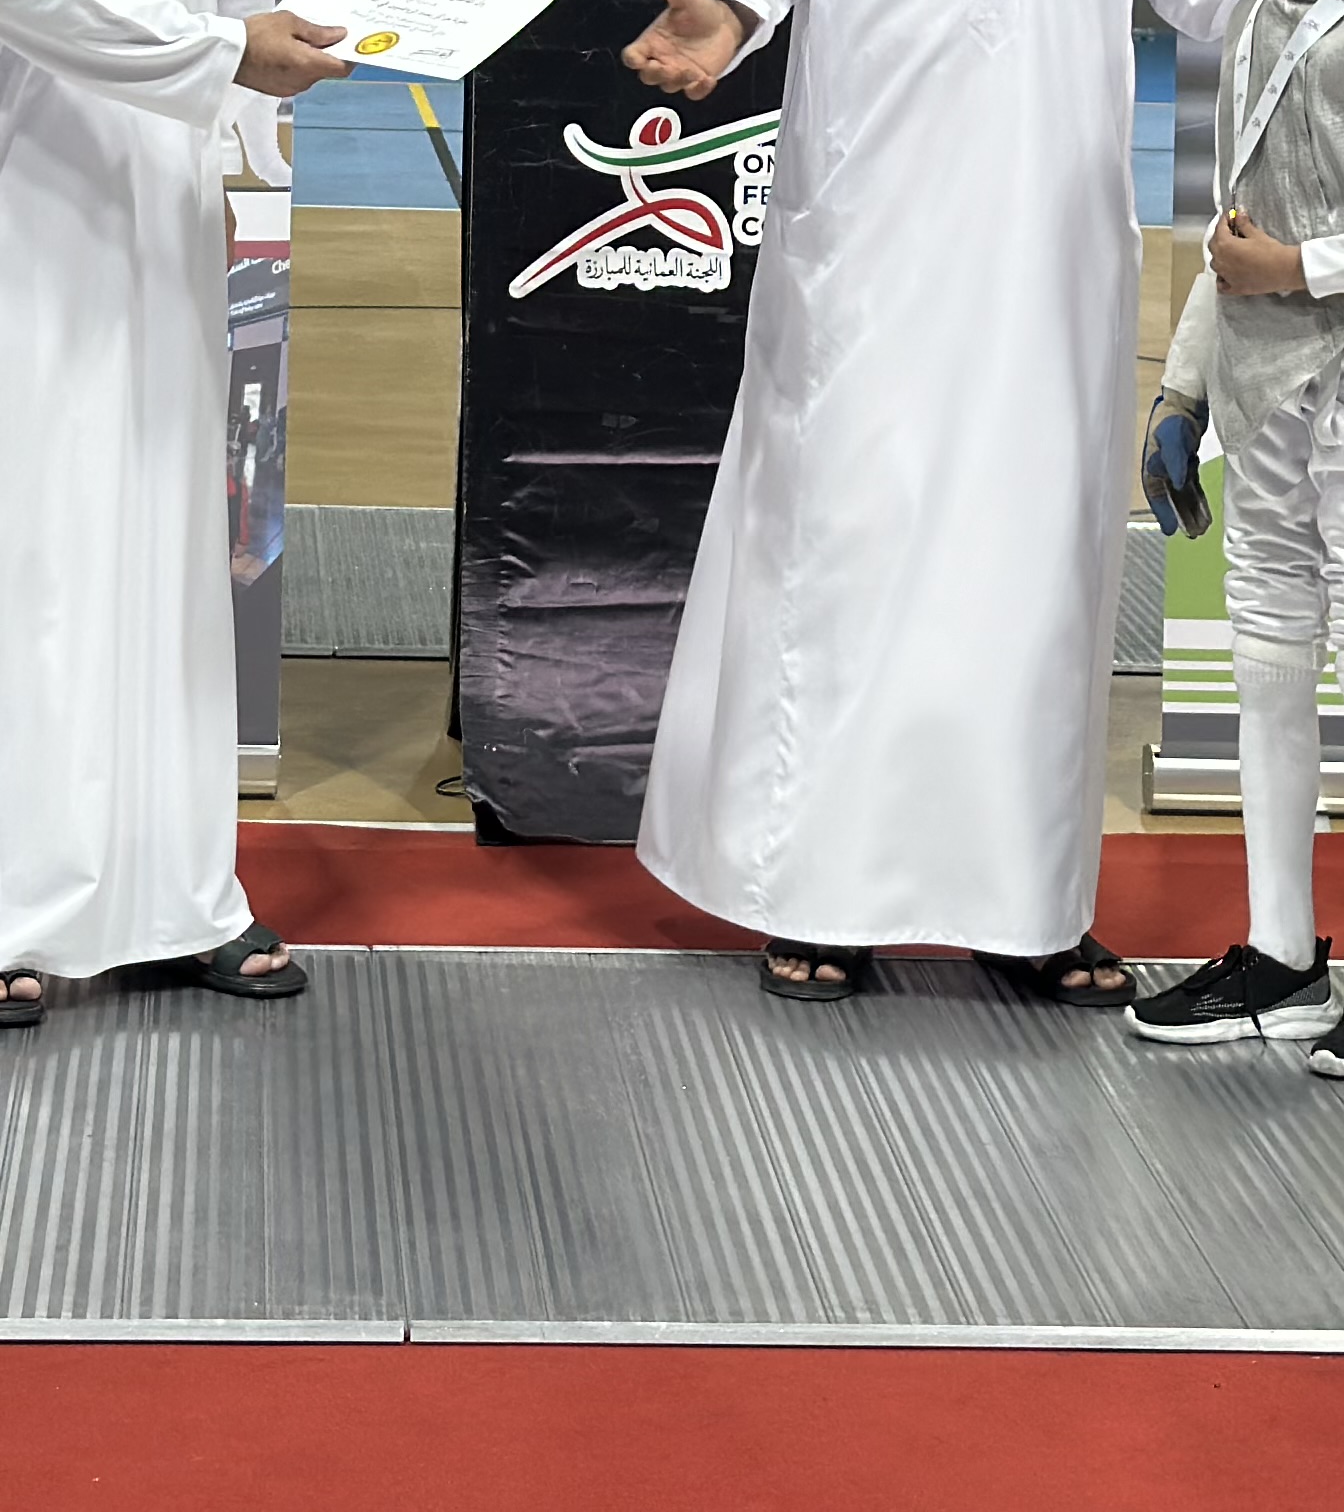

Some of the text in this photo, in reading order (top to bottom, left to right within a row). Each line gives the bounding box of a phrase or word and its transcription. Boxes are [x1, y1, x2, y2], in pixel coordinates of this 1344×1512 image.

[586, 254, 722, 283] اللجنة العمانية للمبارزة
